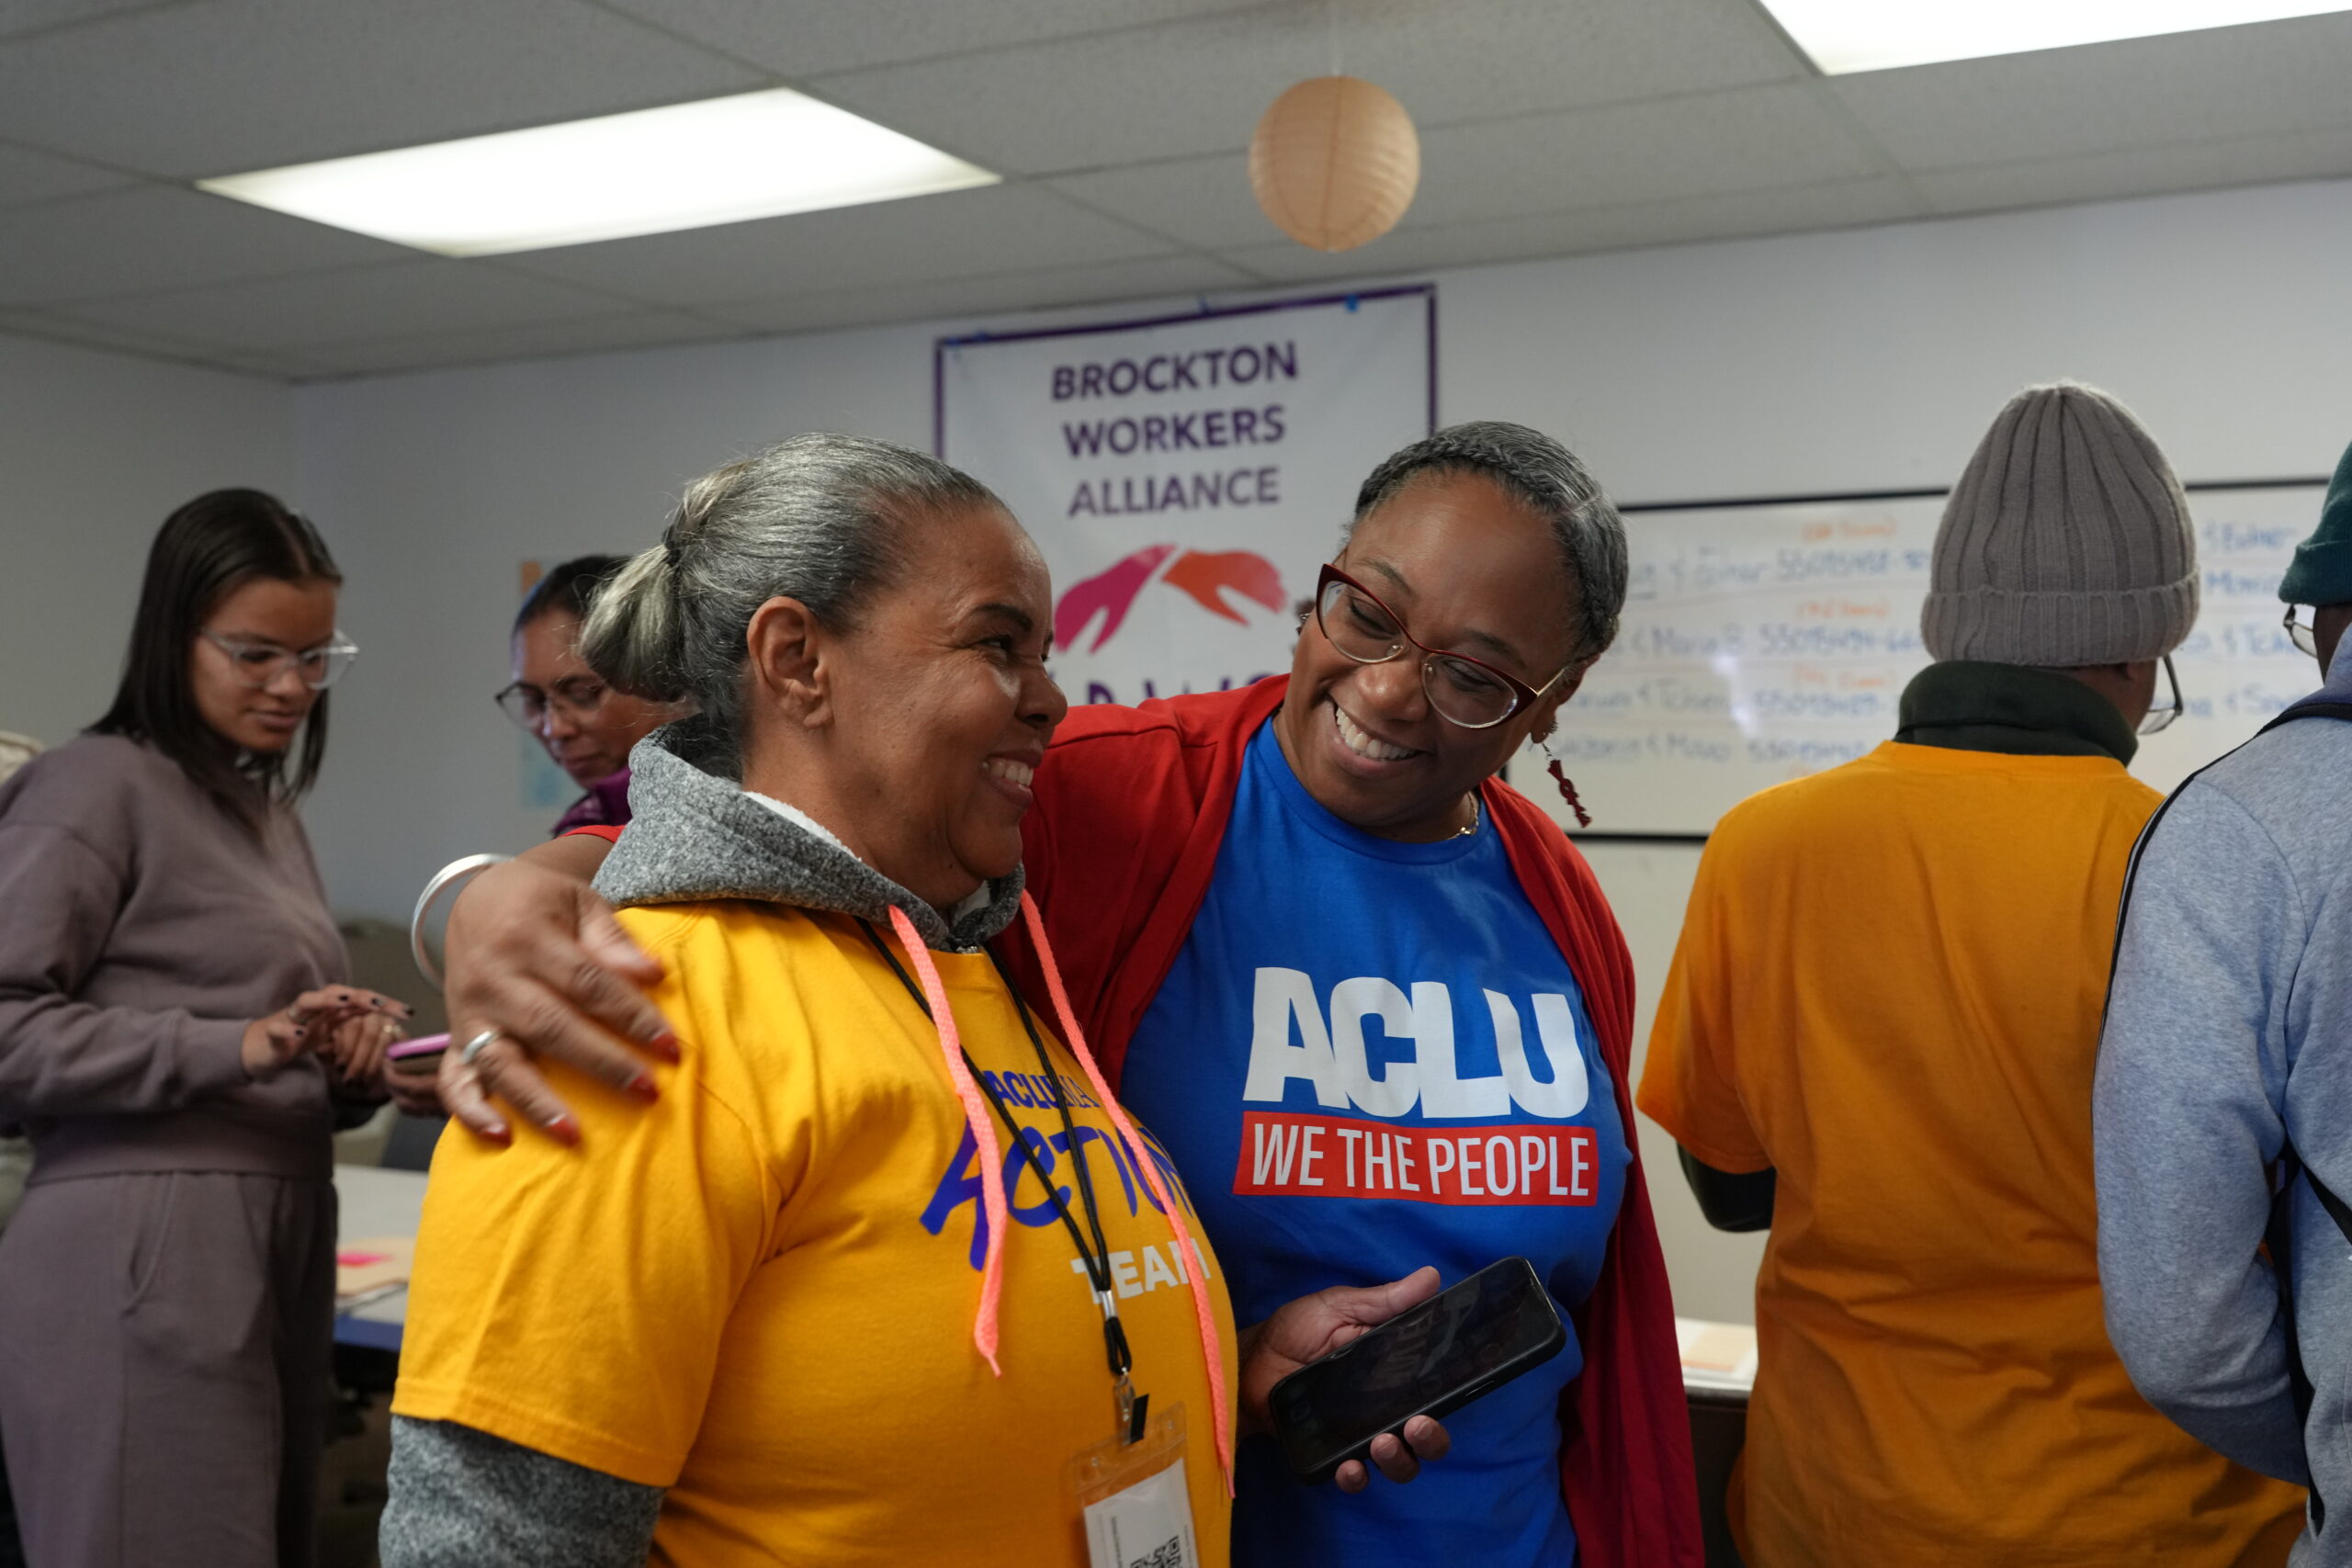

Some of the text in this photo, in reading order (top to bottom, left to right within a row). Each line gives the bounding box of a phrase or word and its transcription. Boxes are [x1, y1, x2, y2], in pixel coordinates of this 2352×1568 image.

[1051, 342, 1298, 401] BROCKTON
[1063, 405, 1286, 458] WORKERS
[1069, 467, 1280, 519] ALLIANCE
[1242, 966, 1589, 1119] ACLU
[1252, 1122, 1589, 1197] WE THE PEOPLE
